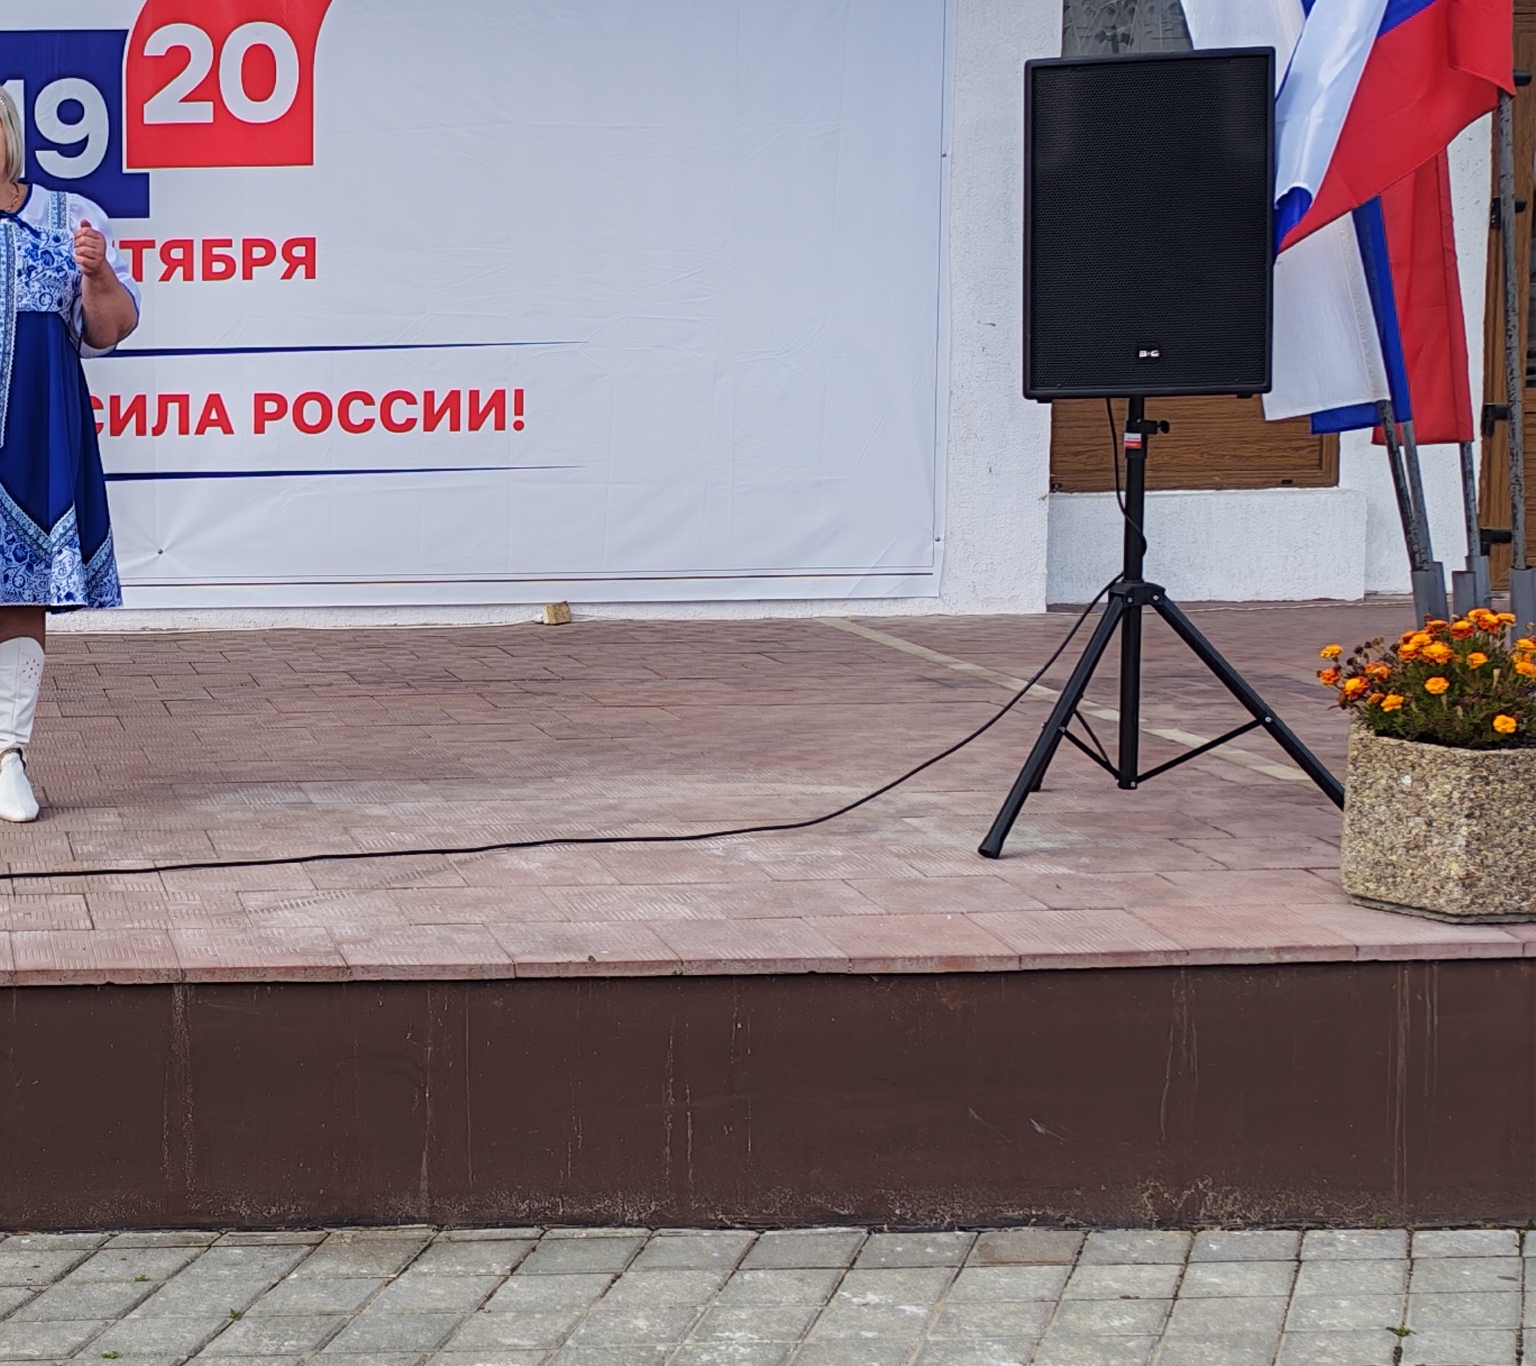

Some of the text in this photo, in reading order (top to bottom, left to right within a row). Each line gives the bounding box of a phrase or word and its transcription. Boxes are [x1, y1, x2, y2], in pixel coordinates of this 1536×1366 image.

[143, 21, 300, 124] 20
[113, 236, 317, 282] ТЯБРЯ
[253, 388, 525, 435] РОССИИ!
